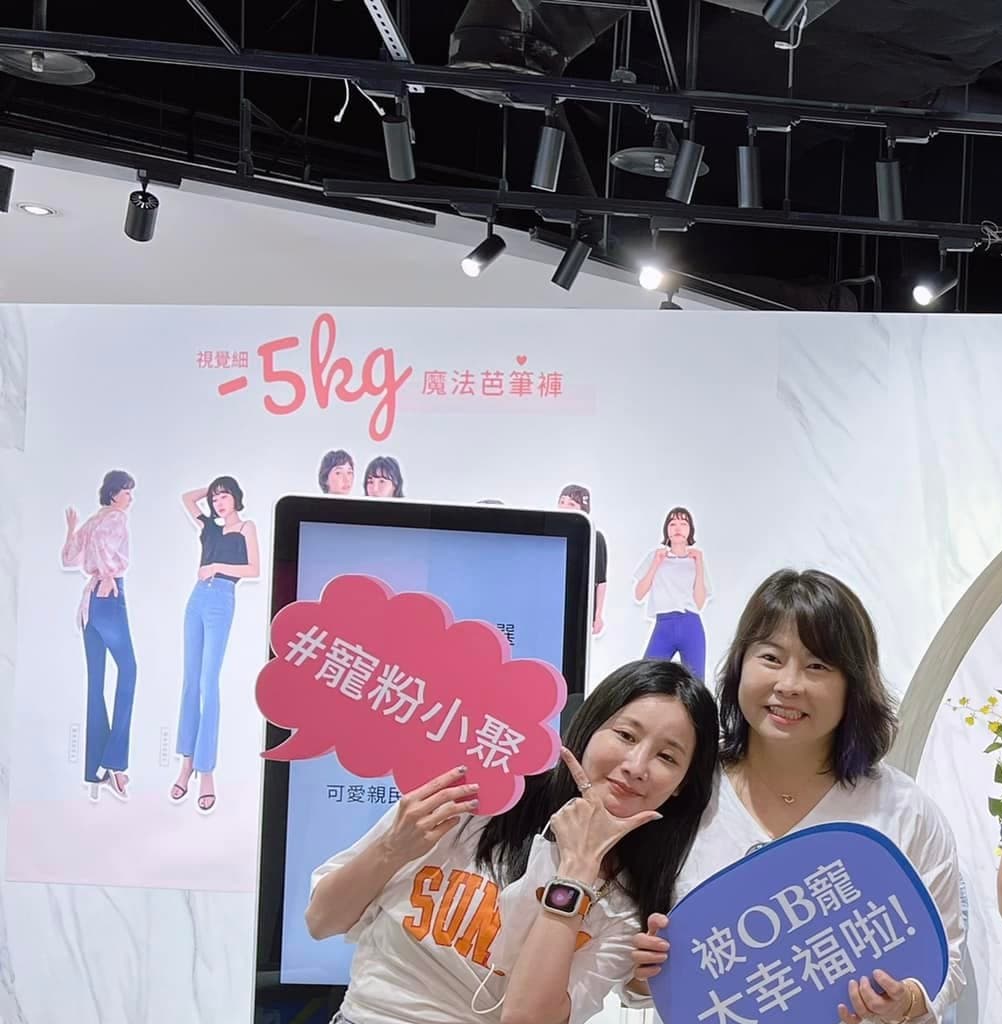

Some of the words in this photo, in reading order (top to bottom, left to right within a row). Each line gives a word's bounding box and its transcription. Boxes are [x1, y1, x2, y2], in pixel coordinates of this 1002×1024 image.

[196, 350, 249, 369] 視覺細
[421, 369, 564, 399] 魔法芭筆褲
